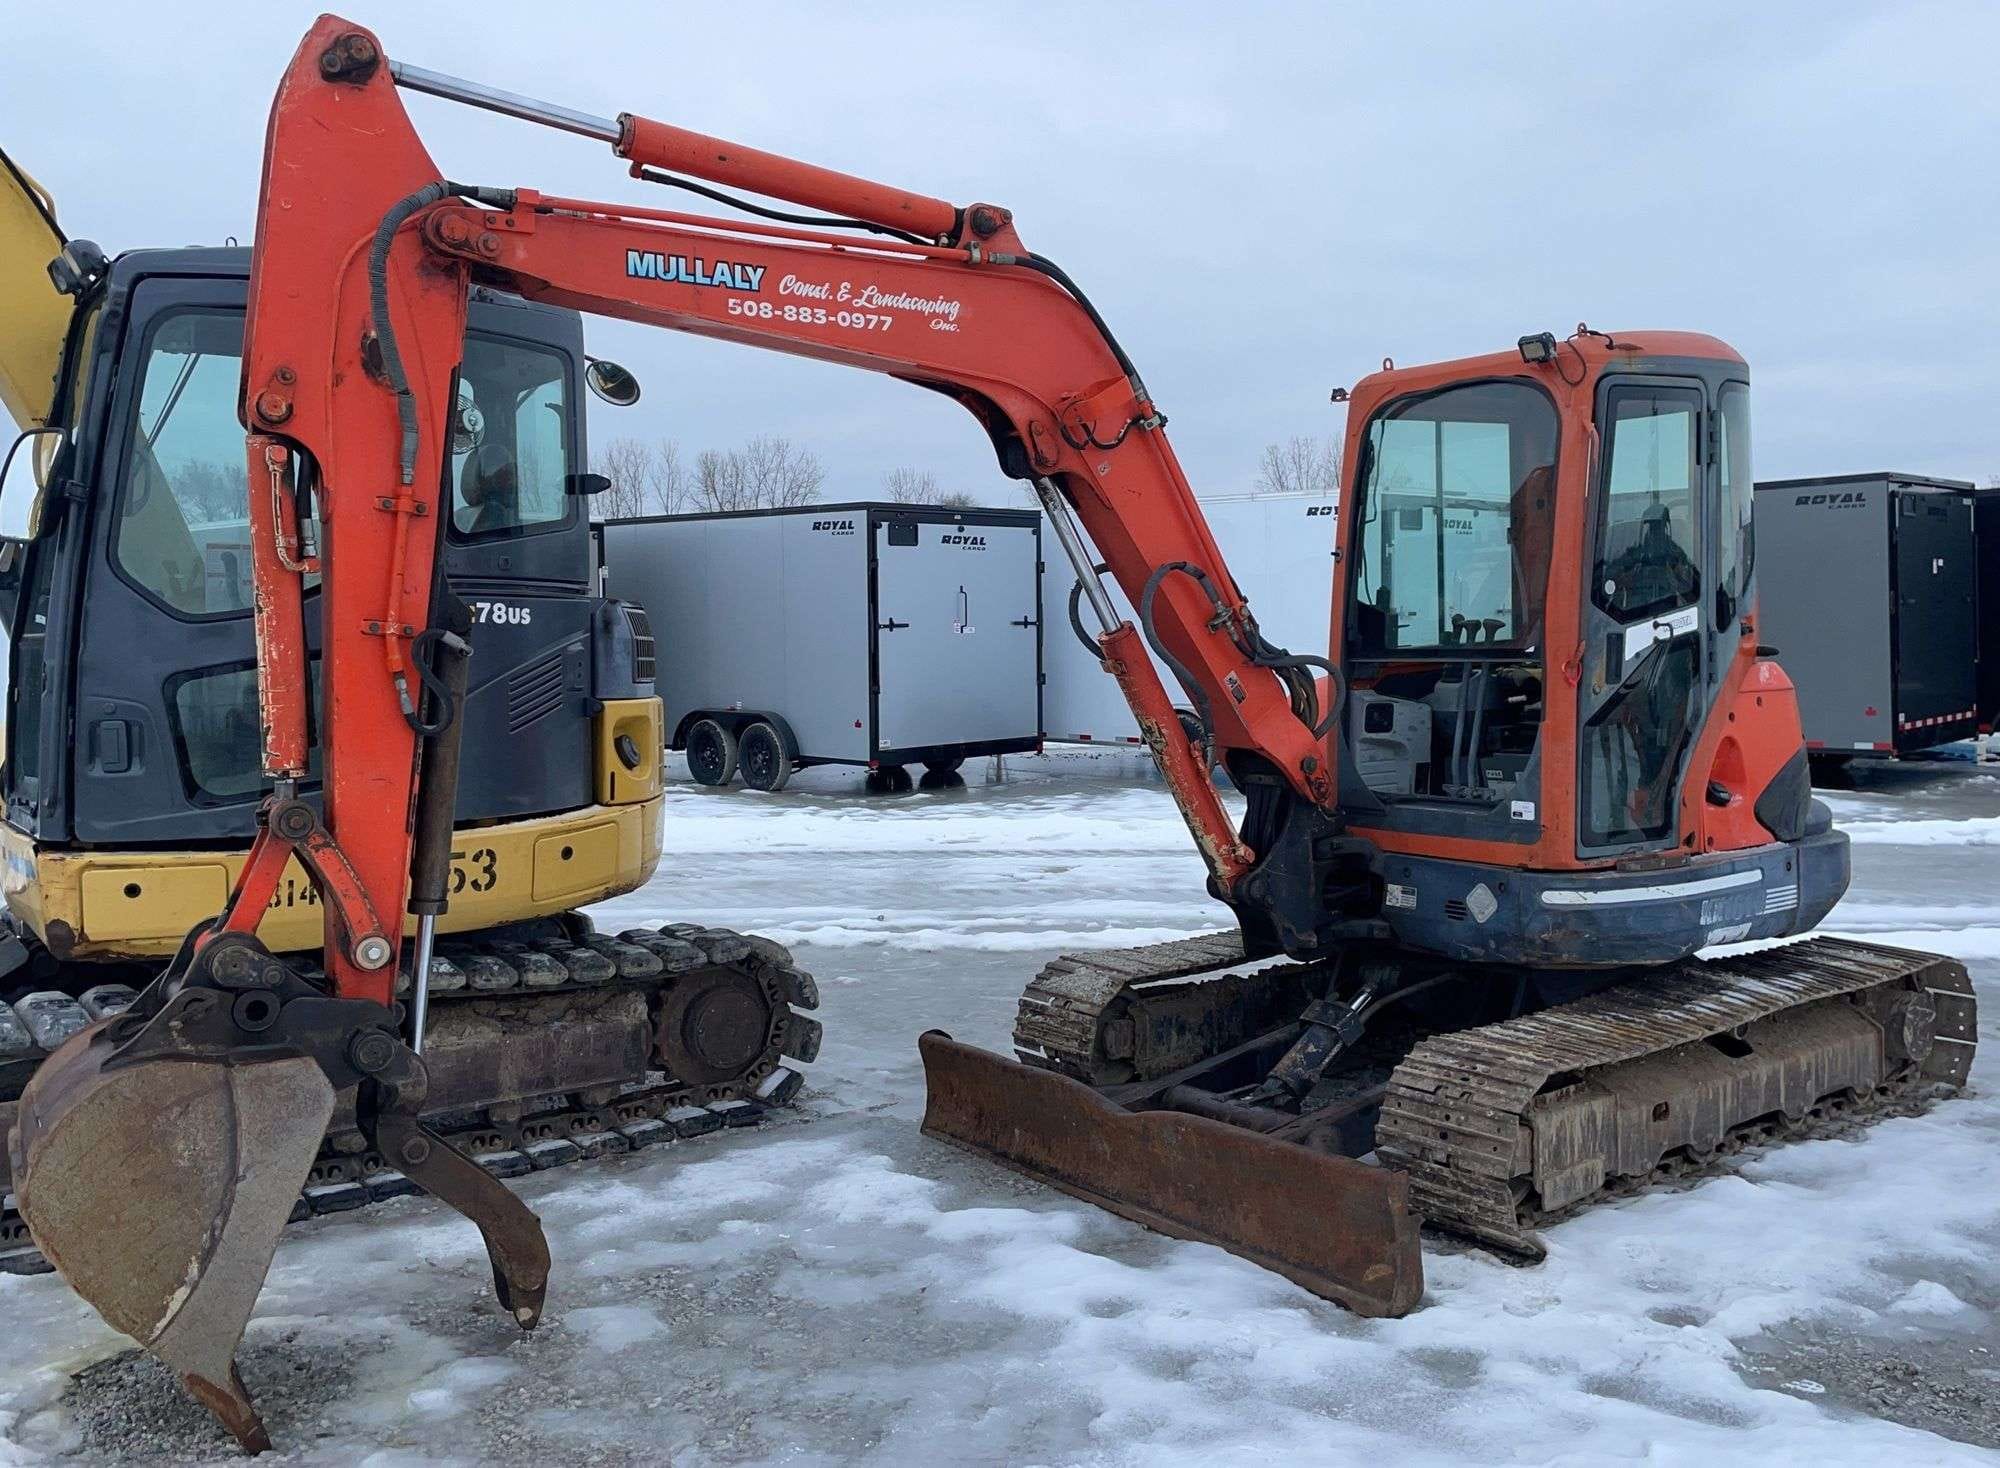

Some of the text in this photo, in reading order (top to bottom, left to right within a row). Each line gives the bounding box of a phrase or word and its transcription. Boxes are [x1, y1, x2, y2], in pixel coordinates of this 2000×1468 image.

[626, 249, 961, 321] MULLALY Const. & Landscaping
[728, 298, 893, 332] 508-883-0977
[929, 318, 960, 332] Inc.
[1795, 492, 1866, 506] ROYAL
[812, 520, 855, 530] ROYAL
[941, 535, 987, 546] ROYAL
